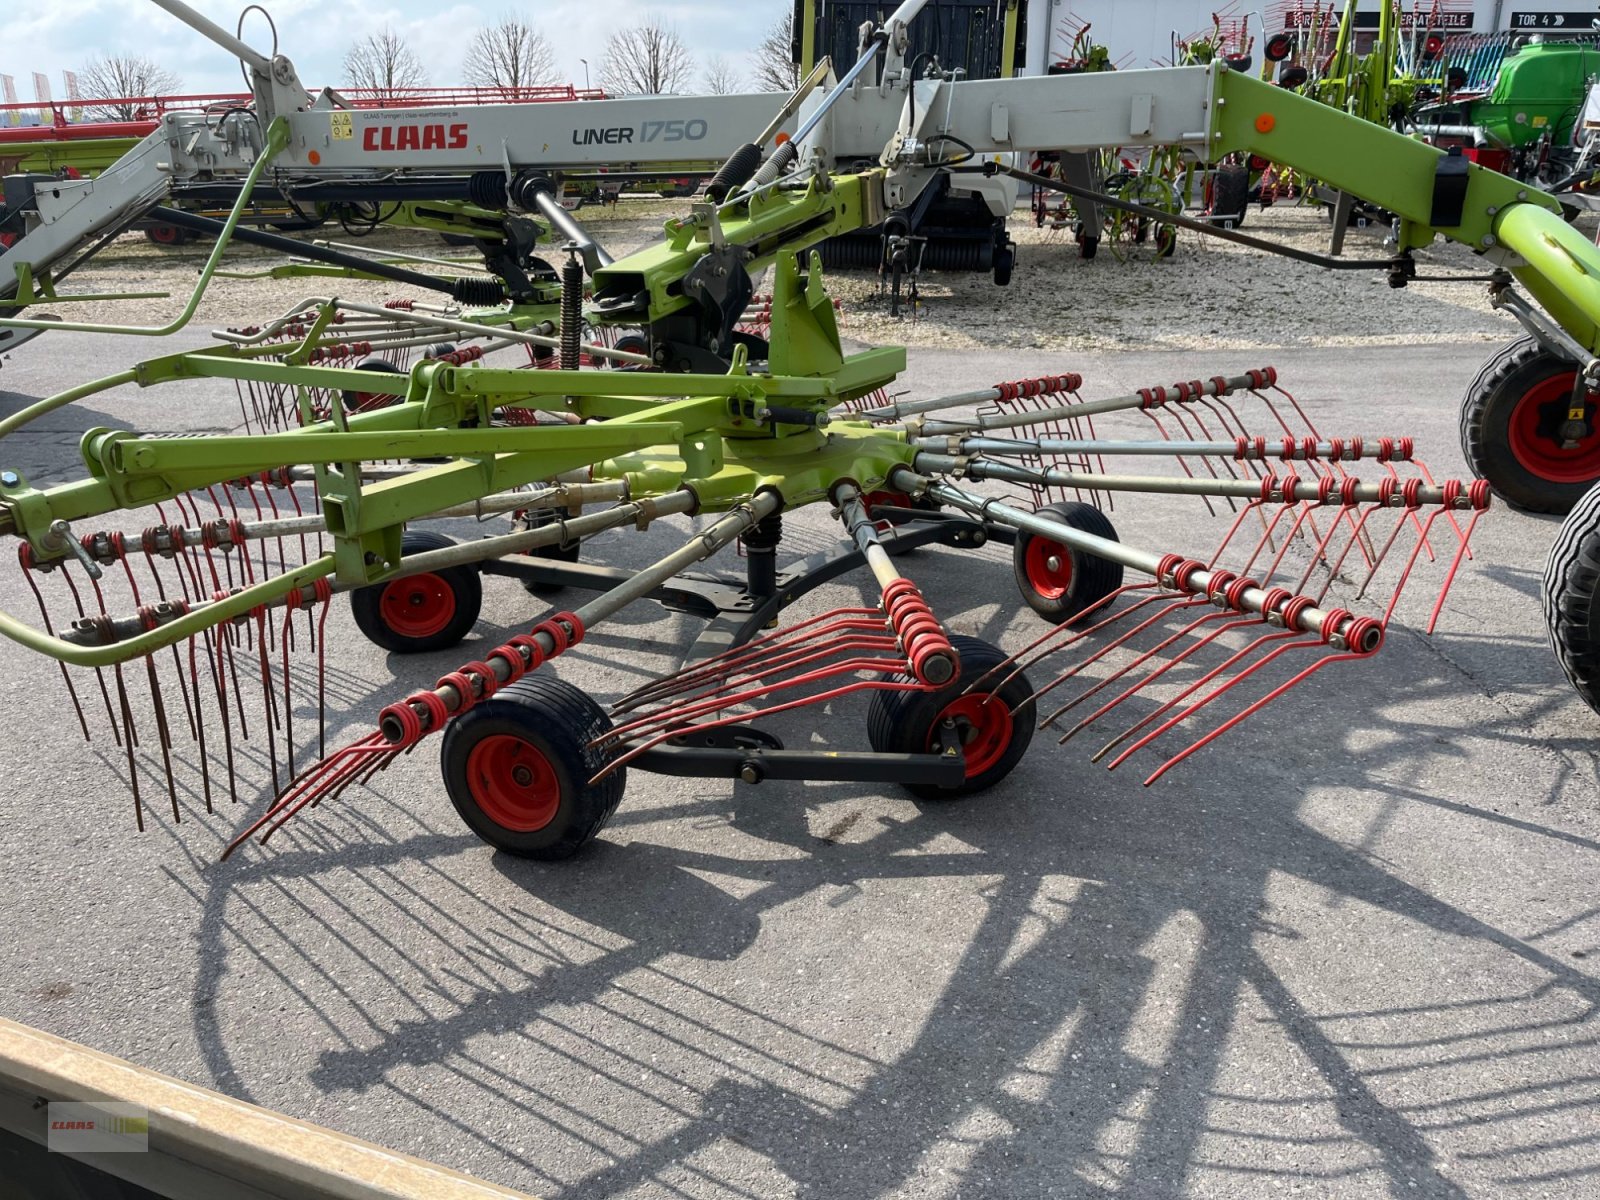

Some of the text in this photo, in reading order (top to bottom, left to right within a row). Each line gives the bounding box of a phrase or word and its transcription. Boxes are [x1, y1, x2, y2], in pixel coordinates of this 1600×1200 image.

[1518, 14, 1549, 26] TOR 4
[363, 124, 468, 152] CLAAS
[572, 119, 708, 145] LINER 1750
